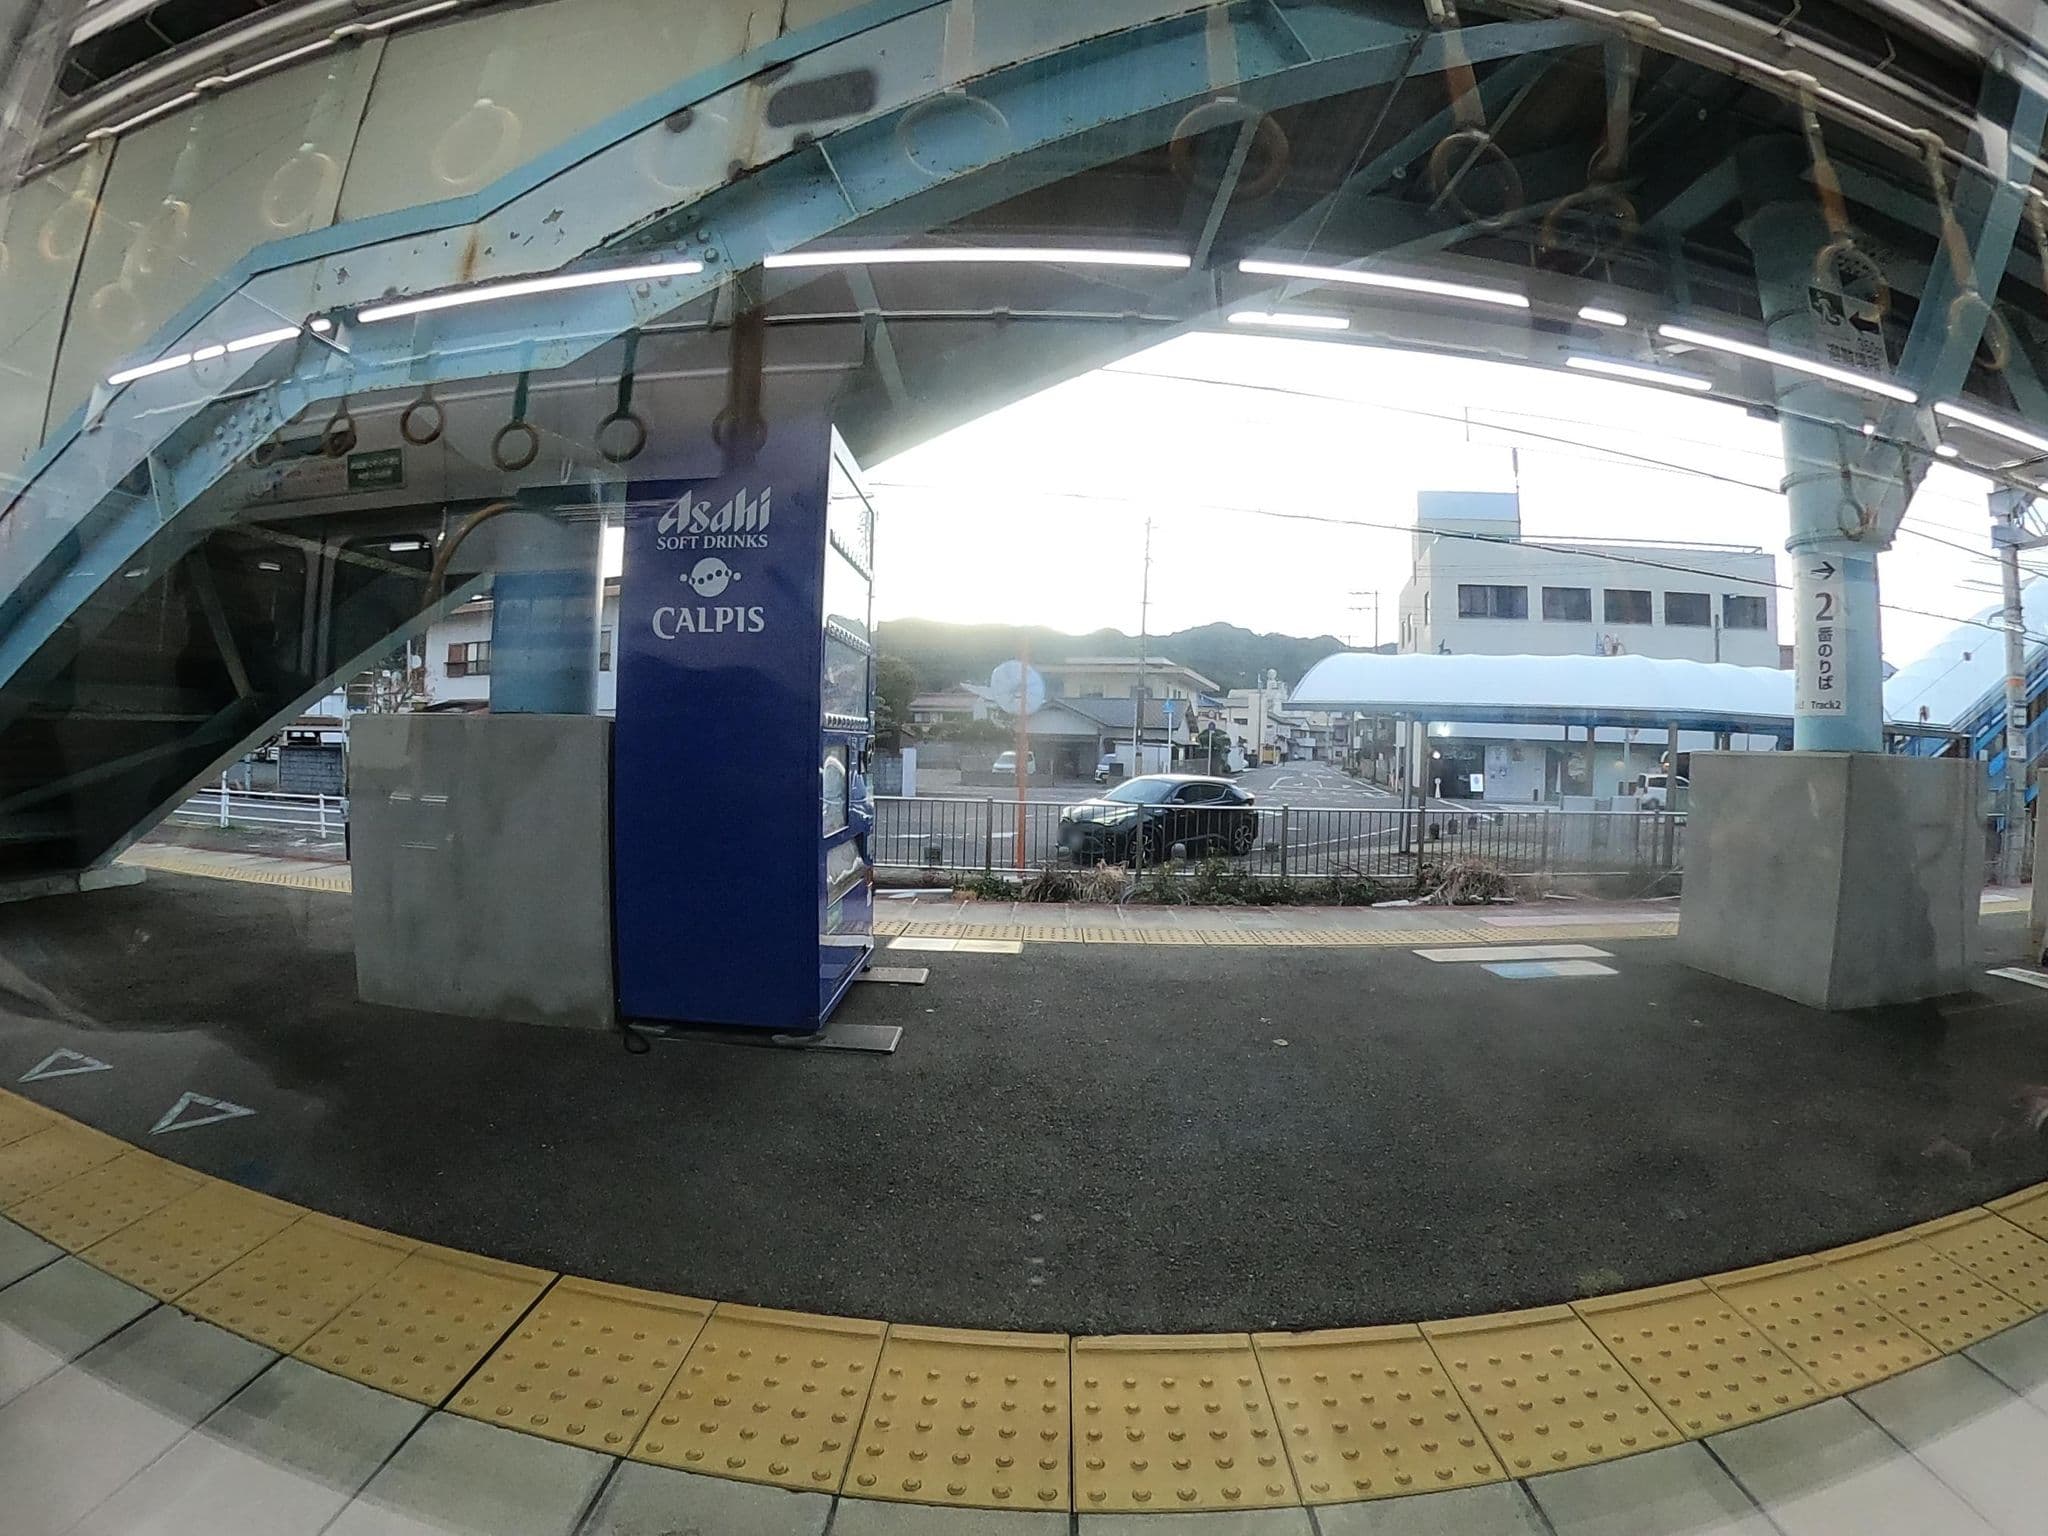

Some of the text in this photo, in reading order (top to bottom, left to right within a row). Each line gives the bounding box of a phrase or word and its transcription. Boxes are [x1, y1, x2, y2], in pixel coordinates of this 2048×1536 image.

[657, 486, 772, 534] Asahi
[656, 534, 768, 550] SOFT DRINKS
[652, 606, 765, 640] CALPIS
